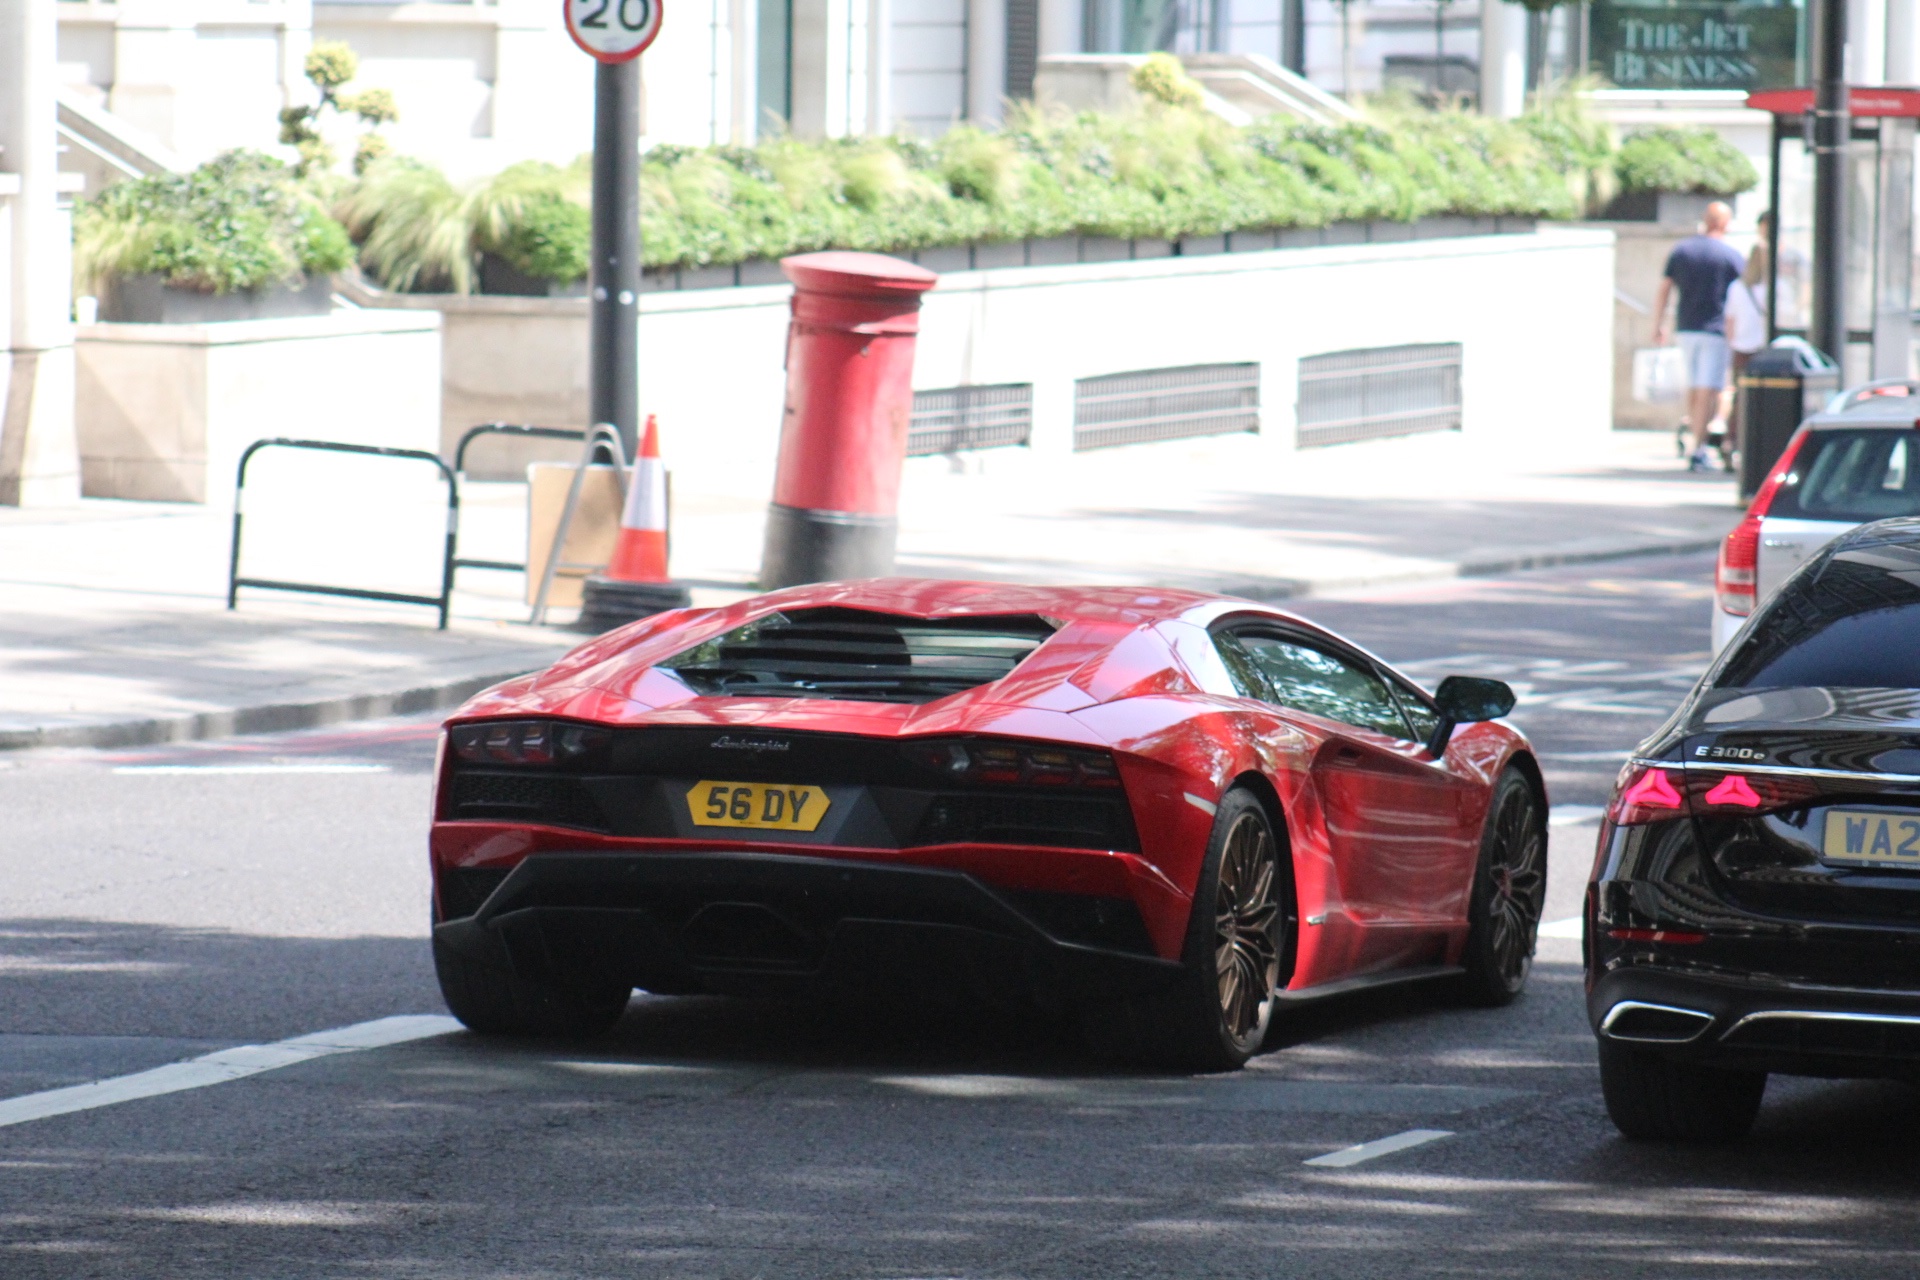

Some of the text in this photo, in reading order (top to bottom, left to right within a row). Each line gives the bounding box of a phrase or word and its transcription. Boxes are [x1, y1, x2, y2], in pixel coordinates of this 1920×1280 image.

[581, 0, 649, 31] 20
[1618, 18, 1754, 50] THE JET
[706, 786, 809, 823] 56 DY
